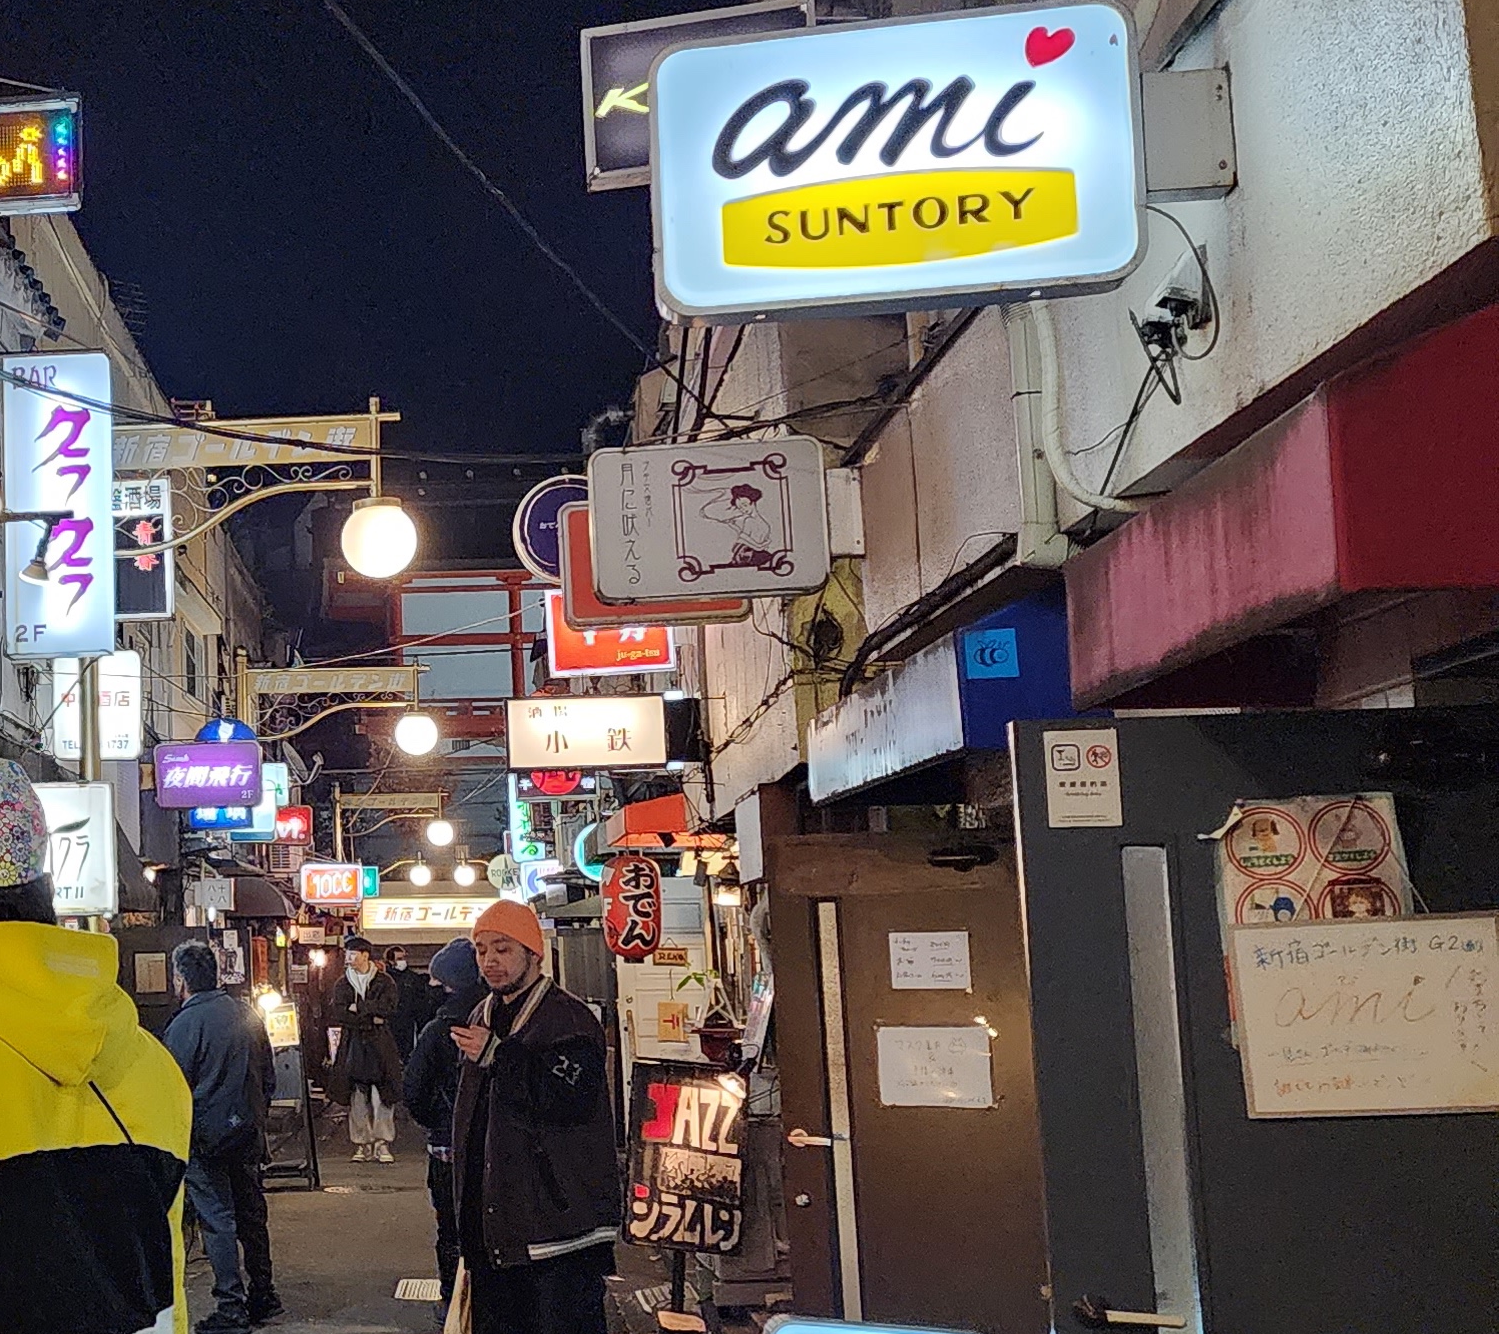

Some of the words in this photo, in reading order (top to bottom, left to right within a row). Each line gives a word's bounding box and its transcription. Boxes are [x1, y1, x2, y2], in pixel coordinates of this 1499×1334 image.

[712, 73, 1045, 180] ami
[764, 187, 1036, 245] SUNTORY
[11, 364, 57, 390] BAR
[619, 463, 642, 585] 月に吠える
[15, 623, 48, 643] 2F
[545, 727, 633, 754] 小鉄
[162, 764, 253, 789] 夜間飛行
[240, 790, 254, 800] 2F
[619, 862, 657, 949] おでん
[641, 1084, 743, 1155] JAZZ
